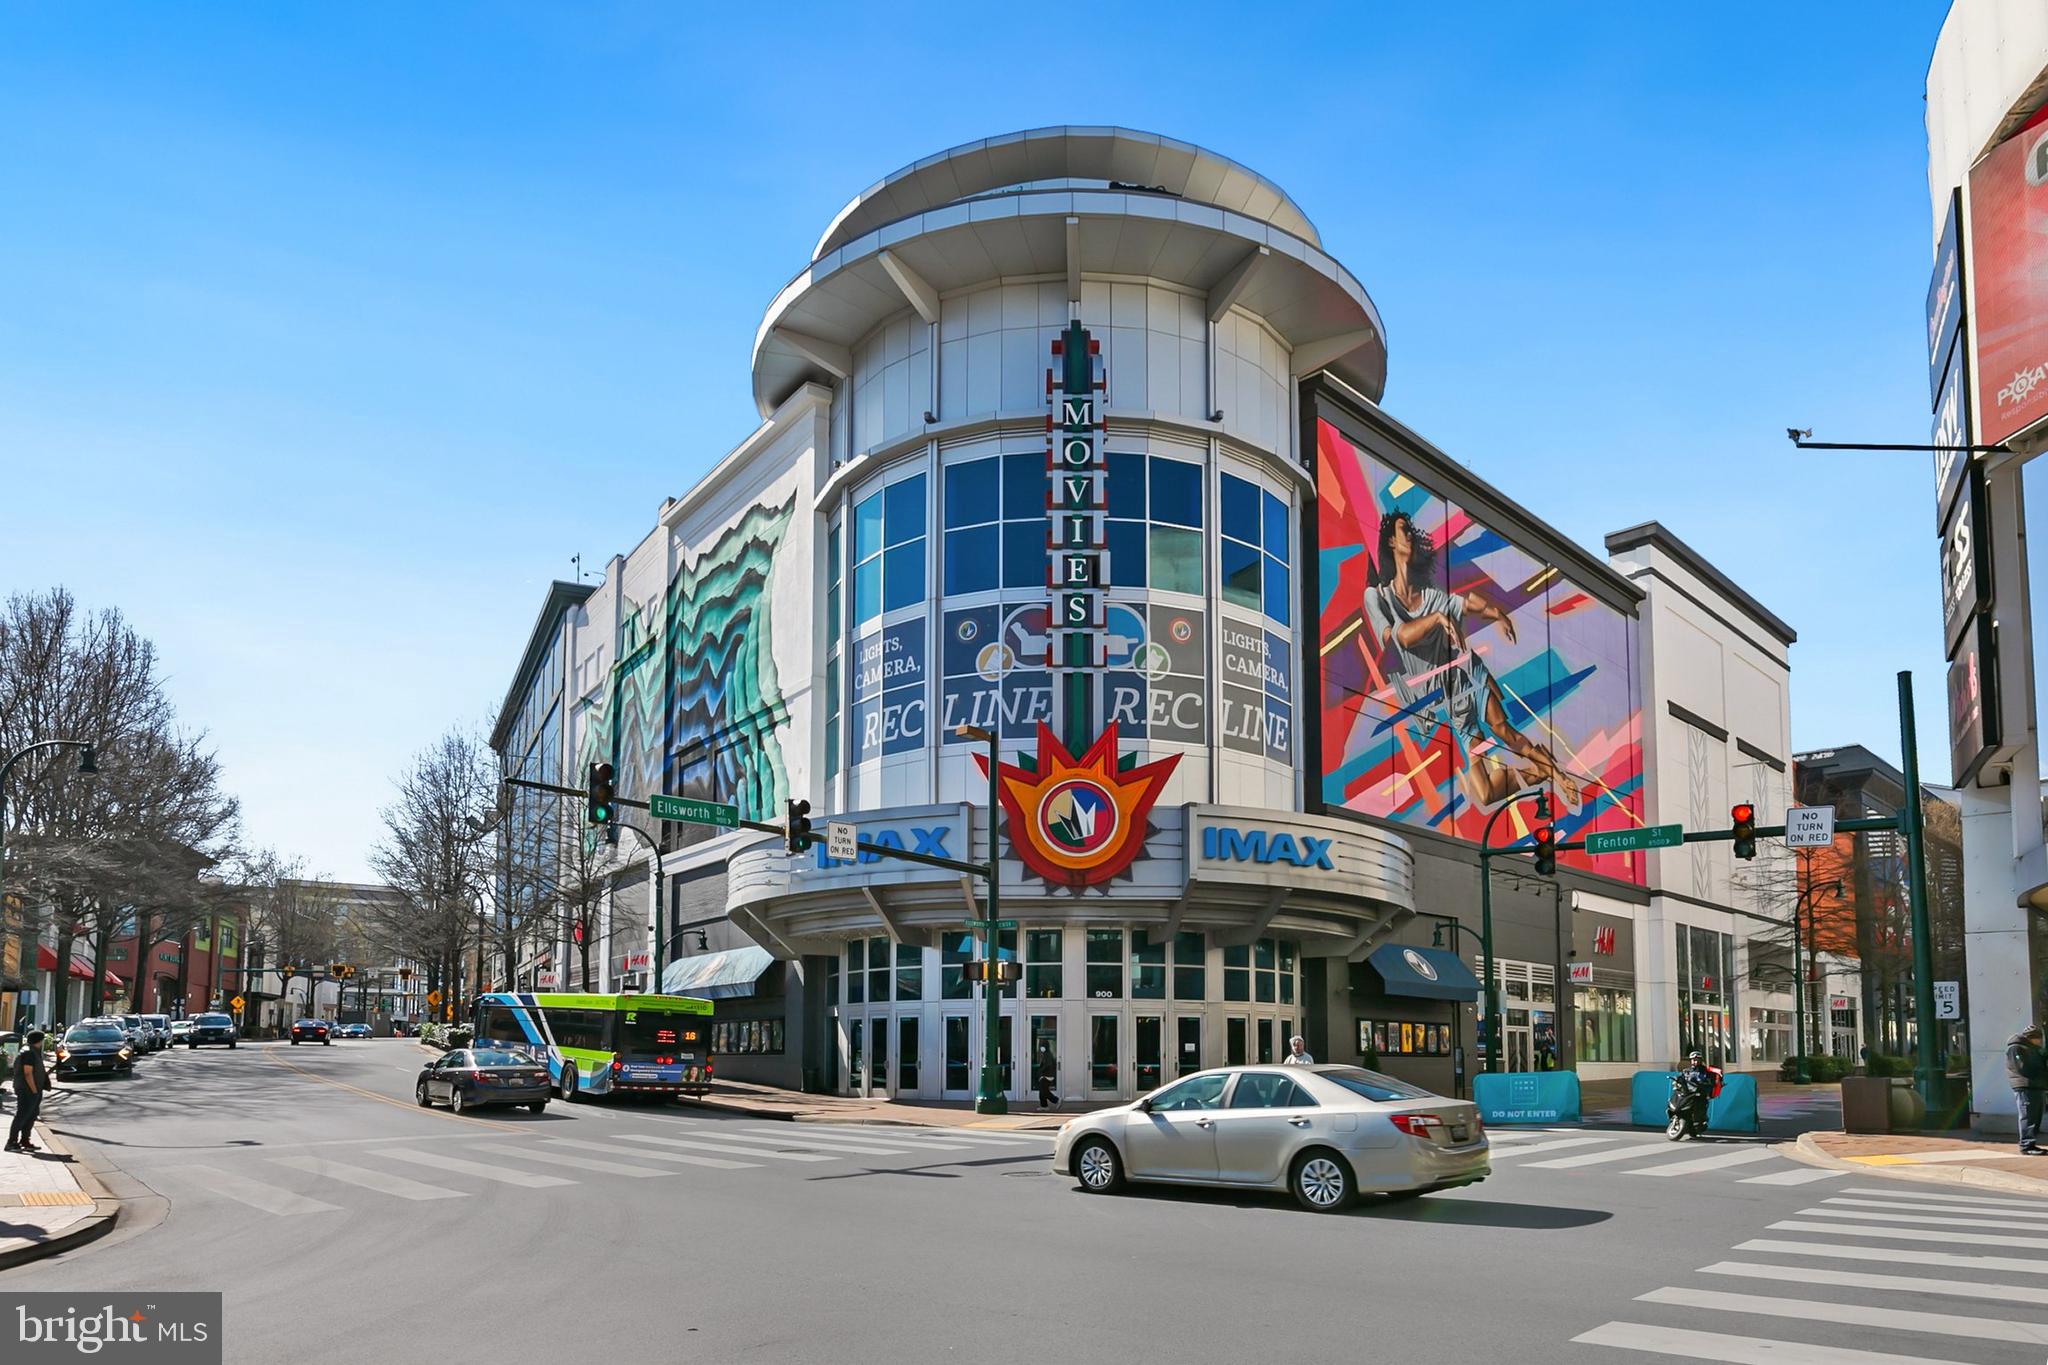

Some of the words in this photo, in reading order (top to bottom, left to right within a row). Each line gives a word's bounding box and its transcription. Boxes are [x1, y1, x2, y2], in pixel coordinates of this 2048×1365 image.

[1063, 402, 1092, 622] MOVIES
[859, 636, 903, 666] LIGHTS,
[1223, 629, 1272, 659] LIGHTS,
[854, 655, 921, 690] CAMERA,
[1225, 654, 1288, 693] CAMERA,
[943, 686, 1053, 730] LINE
[1107, 686, 1203, 730] REC
[862, 699, 925, 750] REC
[1222, 699, 1289, 752] LINE
[657, 800, 710, 819] Ellsworth
[716, 806, 726, 817] Dr
[1802, 812, 1818, 820] NO
[837, 827, 848, 835] NO
[1597, 836, 1636, 849] Fenton
[1652, 828, 1662, 837] St
[1790, 834, 1803, 843] ON
[1808, 832, 1829, 842] RED
[1797, 822, 1824, 832] TURN
[830, 846, 840, 855] ON
[841, 847, 855, 856] RED
[834, 836, 851, 845] TURN
[1203, 826, 1335, 870] IMAX
[1096, 990, 1113, 998] 900
[1492, 1110, 1505, 1118] DO
[1507, 1110, 1525, 1118] NOT
[1527, 1110, 1557, 1118] ENTER
